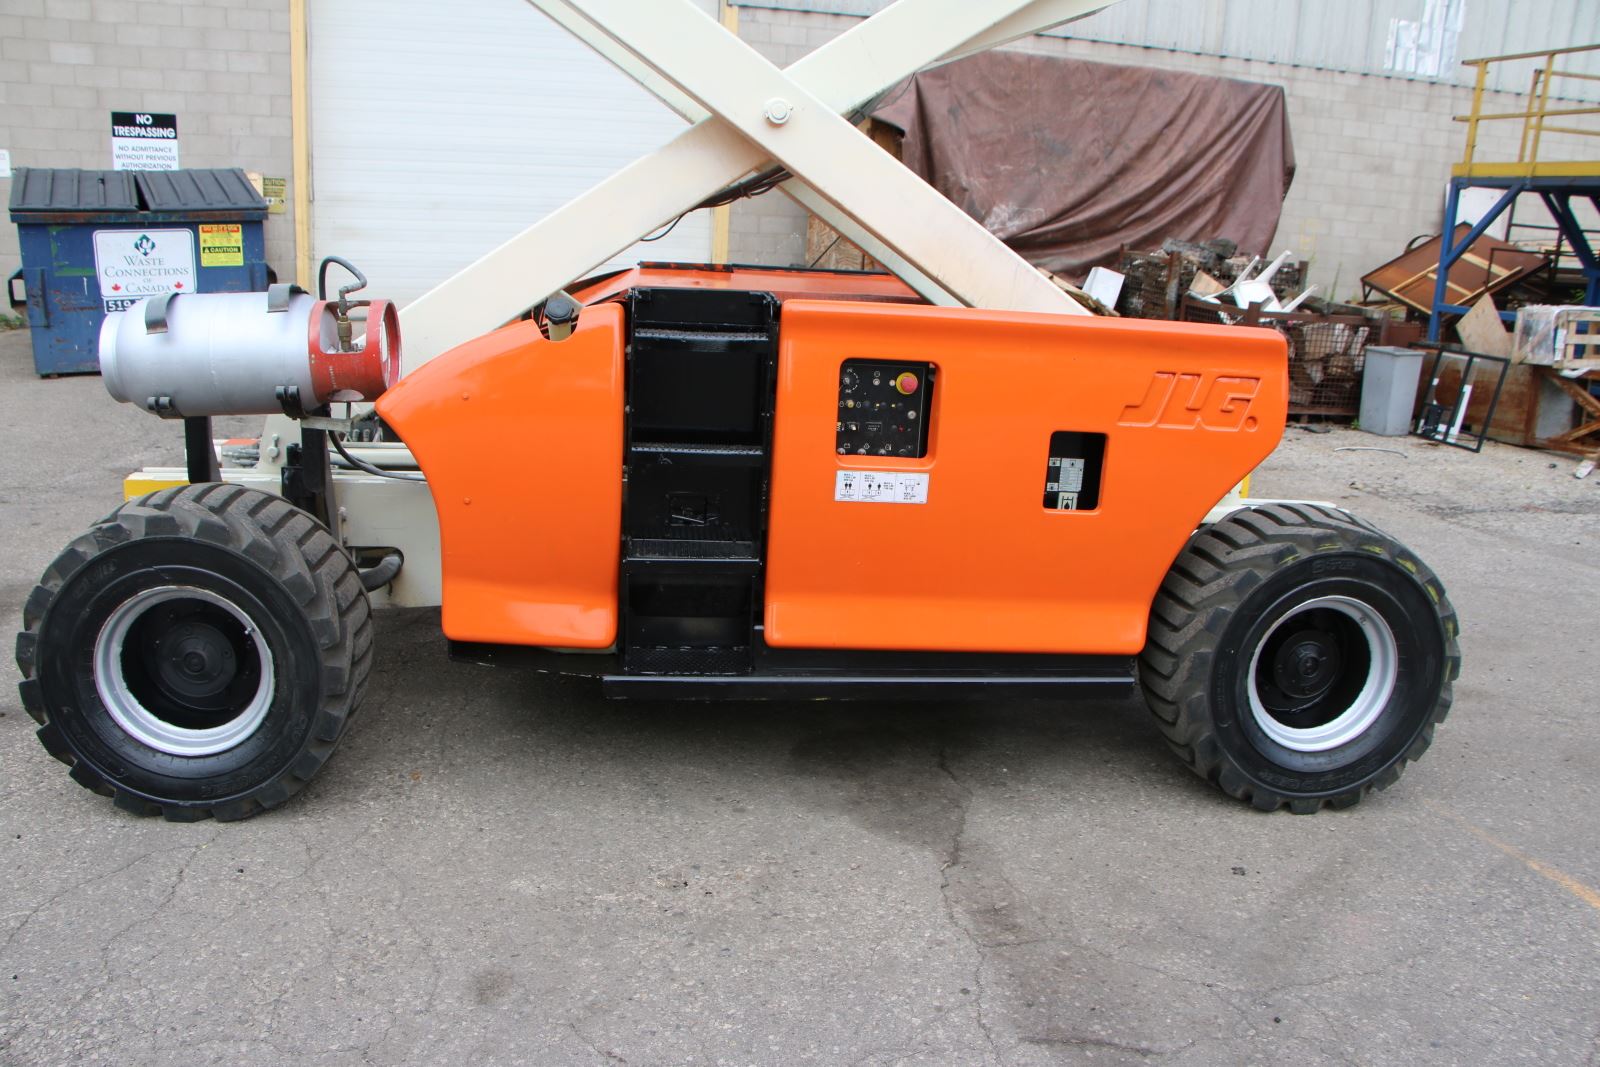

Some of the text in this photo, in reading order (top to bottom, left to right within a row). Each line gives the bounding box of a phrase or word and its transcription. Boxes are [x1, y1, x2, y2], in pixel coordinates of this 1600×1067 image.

[135, 113, 153, 125] NO
[113, 125, 176, 138] TRESPASSING
[131, 145, 172, 153] ADMITTANCE
[121, 161, 172, 169] AUTHORIZATION
